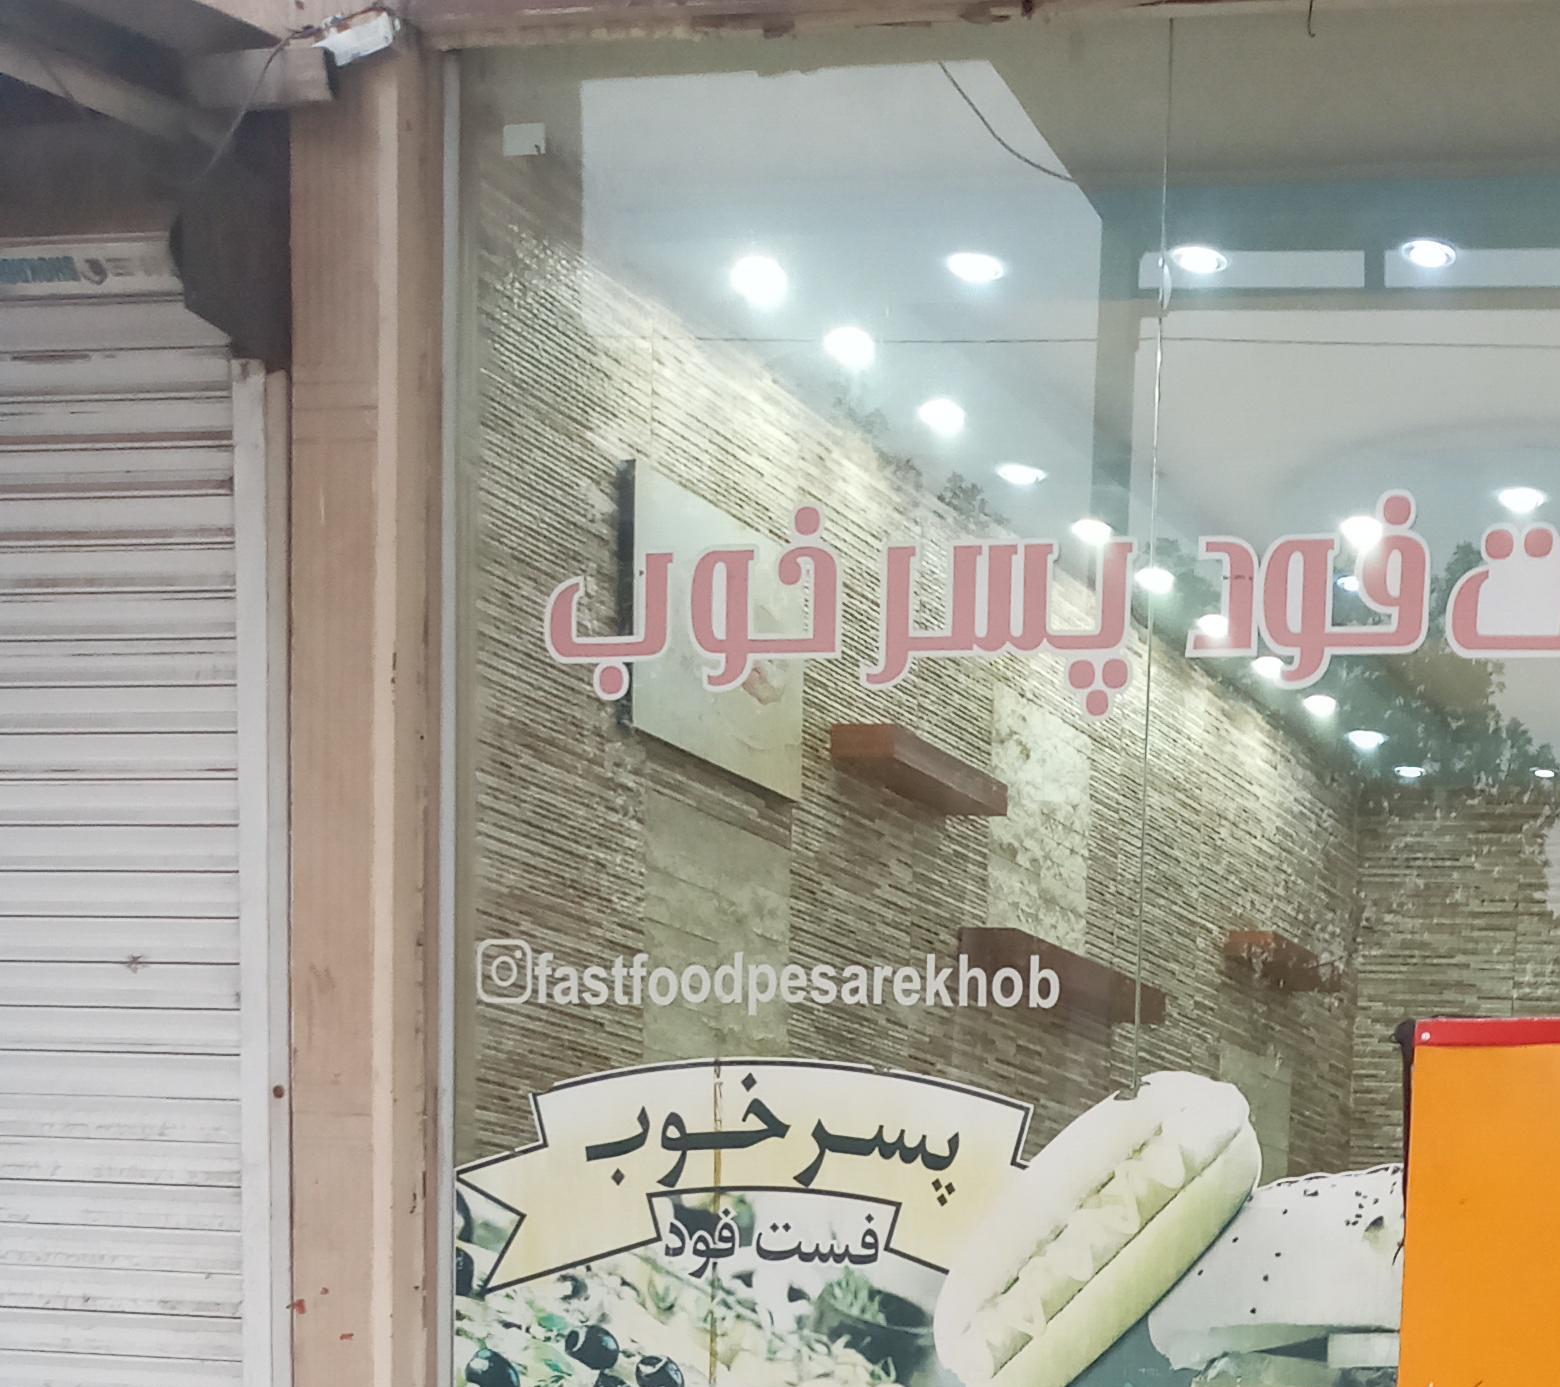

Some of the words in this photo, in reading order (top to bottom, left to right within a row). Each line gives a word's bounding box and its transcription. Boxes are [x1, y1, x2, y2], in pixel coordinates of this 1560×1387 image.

[546, 504, 839, 701] خوب
[863, 540, 1136, 719] پسر
[1187, 489, 1430, 688] فود
[534, 951, 1061, 1014] fastfoodpesarekhob
[584, 1072, 792, 1189] خوب
[793, 1116, 961, 1208] پسر
[664, 1207, 739, 1278] فود
[756, 1213, 880, 1266] فست
